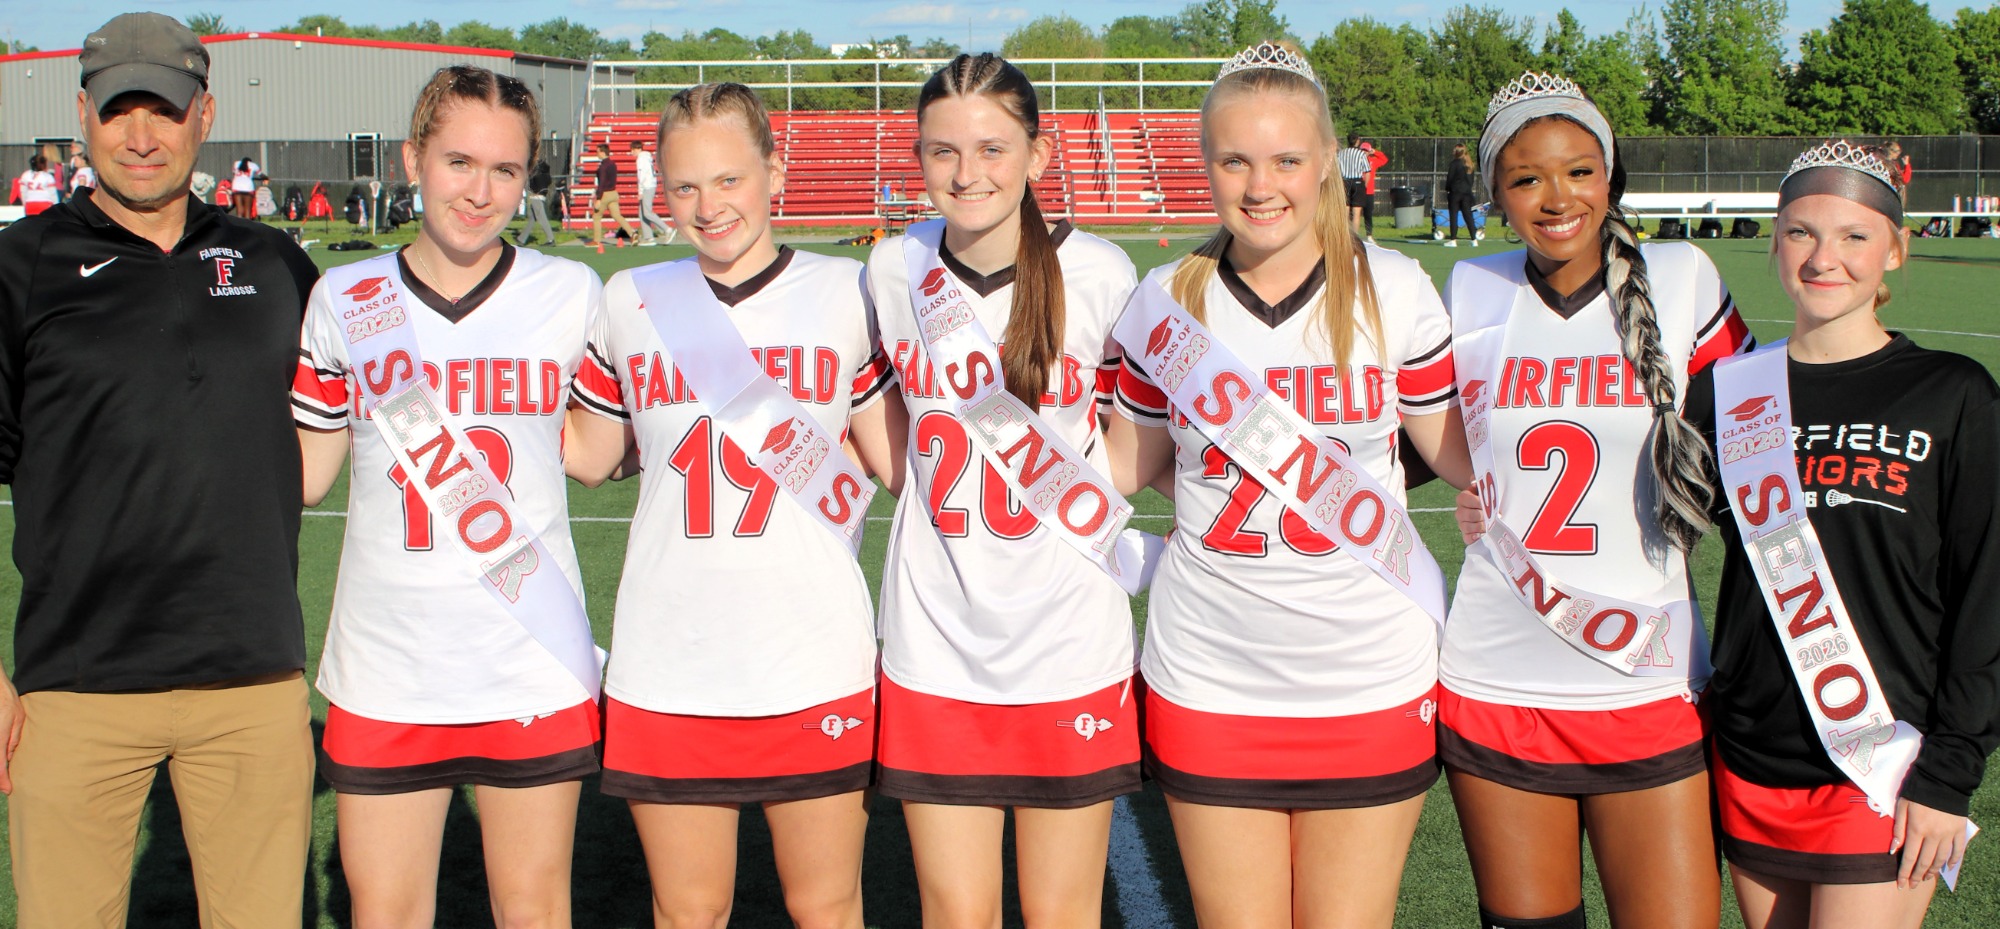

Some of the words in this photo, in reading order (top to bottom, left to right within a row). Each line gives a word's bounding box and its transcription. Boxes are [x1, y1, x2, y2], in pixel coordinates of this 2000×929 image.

[199, 247, 243, 260] FAIRFIELD
[214, 257, 235, 286] F
[209, 285, 258, 297] LACROSSE
[344, 300, 380, 320] CLASS
[382, 293, 398, 306] OF
[920, 295, 947, 318] CLASS
[347, 305, 406, 344] 2026
[925, 301, 976, 345] 2026
[1155, 342, 1179, 377] CLASS
[1178, 324, 1191, 341] OF
[1163, 333, 1211, 395] 2026
[627, 345, 840, 412] FAIELD
[1492, 354, 1654, 410] IRFIEL
[1722, 422, 1760, 439] CLASS
[1765, 413, 1782, 425] OF
[1723, 427, 1786, 464] 2026
[1792, 423, 1932, 462] RFIELD
[773, 440, 804, 476] CLASS
[802, 428, 816, 443] OF
[785, 437, 830, 495] 2026
[669, 415, 780, 539] 19
[1517, 420, 1600, 556] 2
[1795, 455, 1910, 496] IORS
[1315, 469, 1357, 525] 2026
[1798, 633, 1851, 672] 2026
[828, 719, 837, 731] F
[1081, 718, 1090, 731] F
